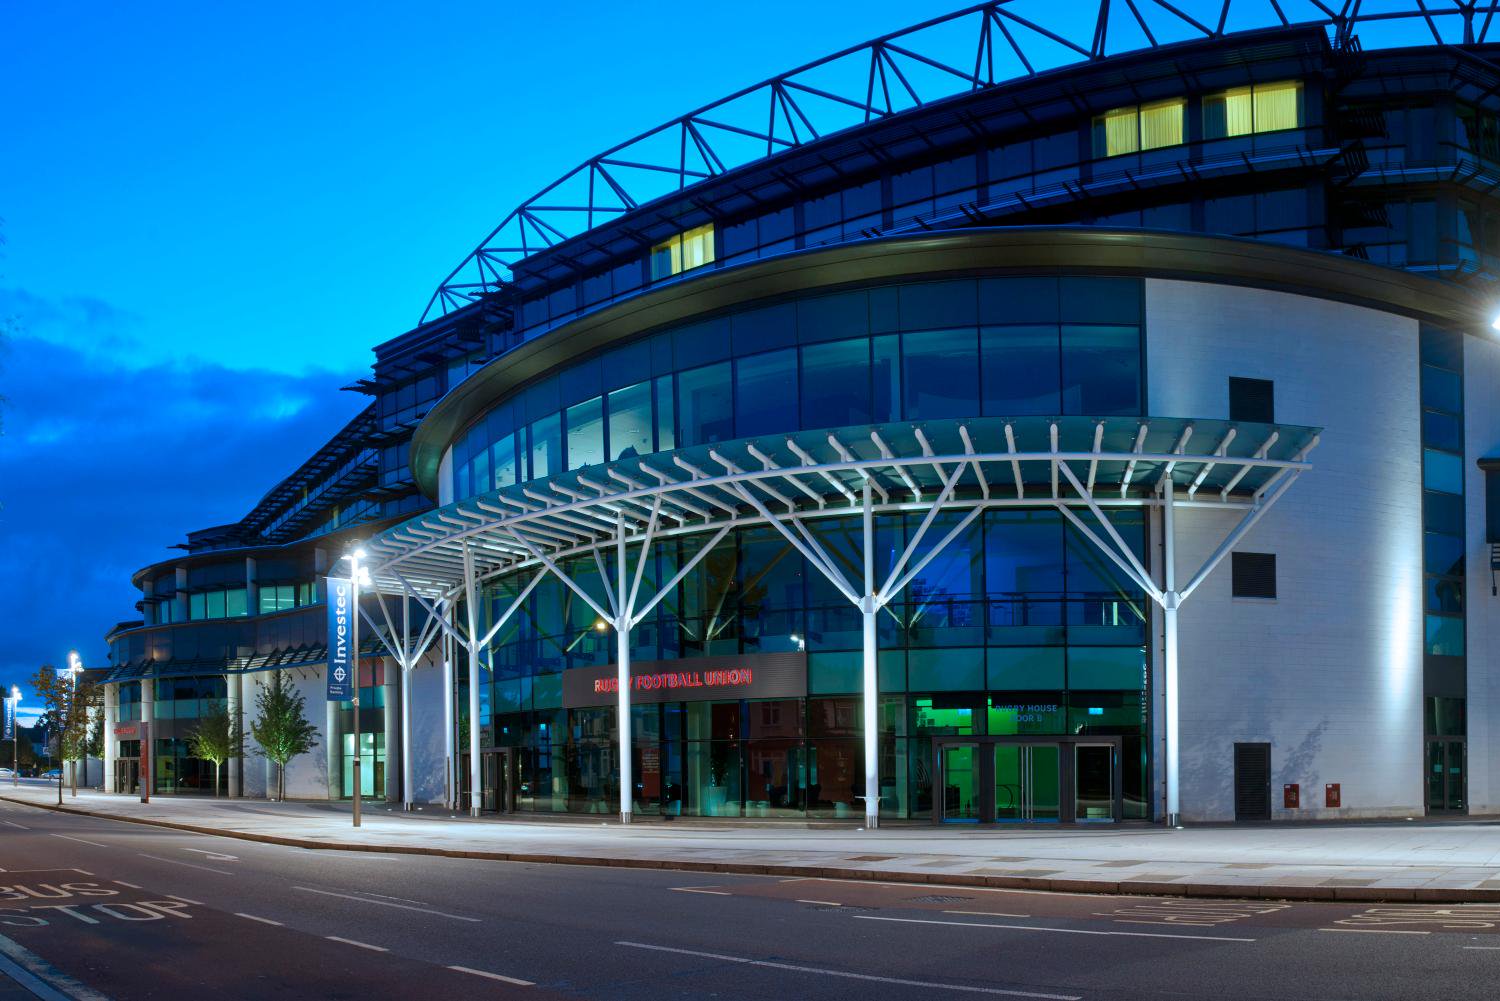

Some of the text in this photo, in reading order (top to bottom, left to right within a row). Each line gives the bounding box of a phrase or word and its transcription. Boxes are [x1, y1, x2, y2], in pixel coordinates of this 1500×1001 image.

[334, 585, 347, 664] Investec
[636, 672, 702, 690] FOOTBALL
[704, 668, 753, 687] UNION
[1027, 704, 1057, 712] HOUSE
